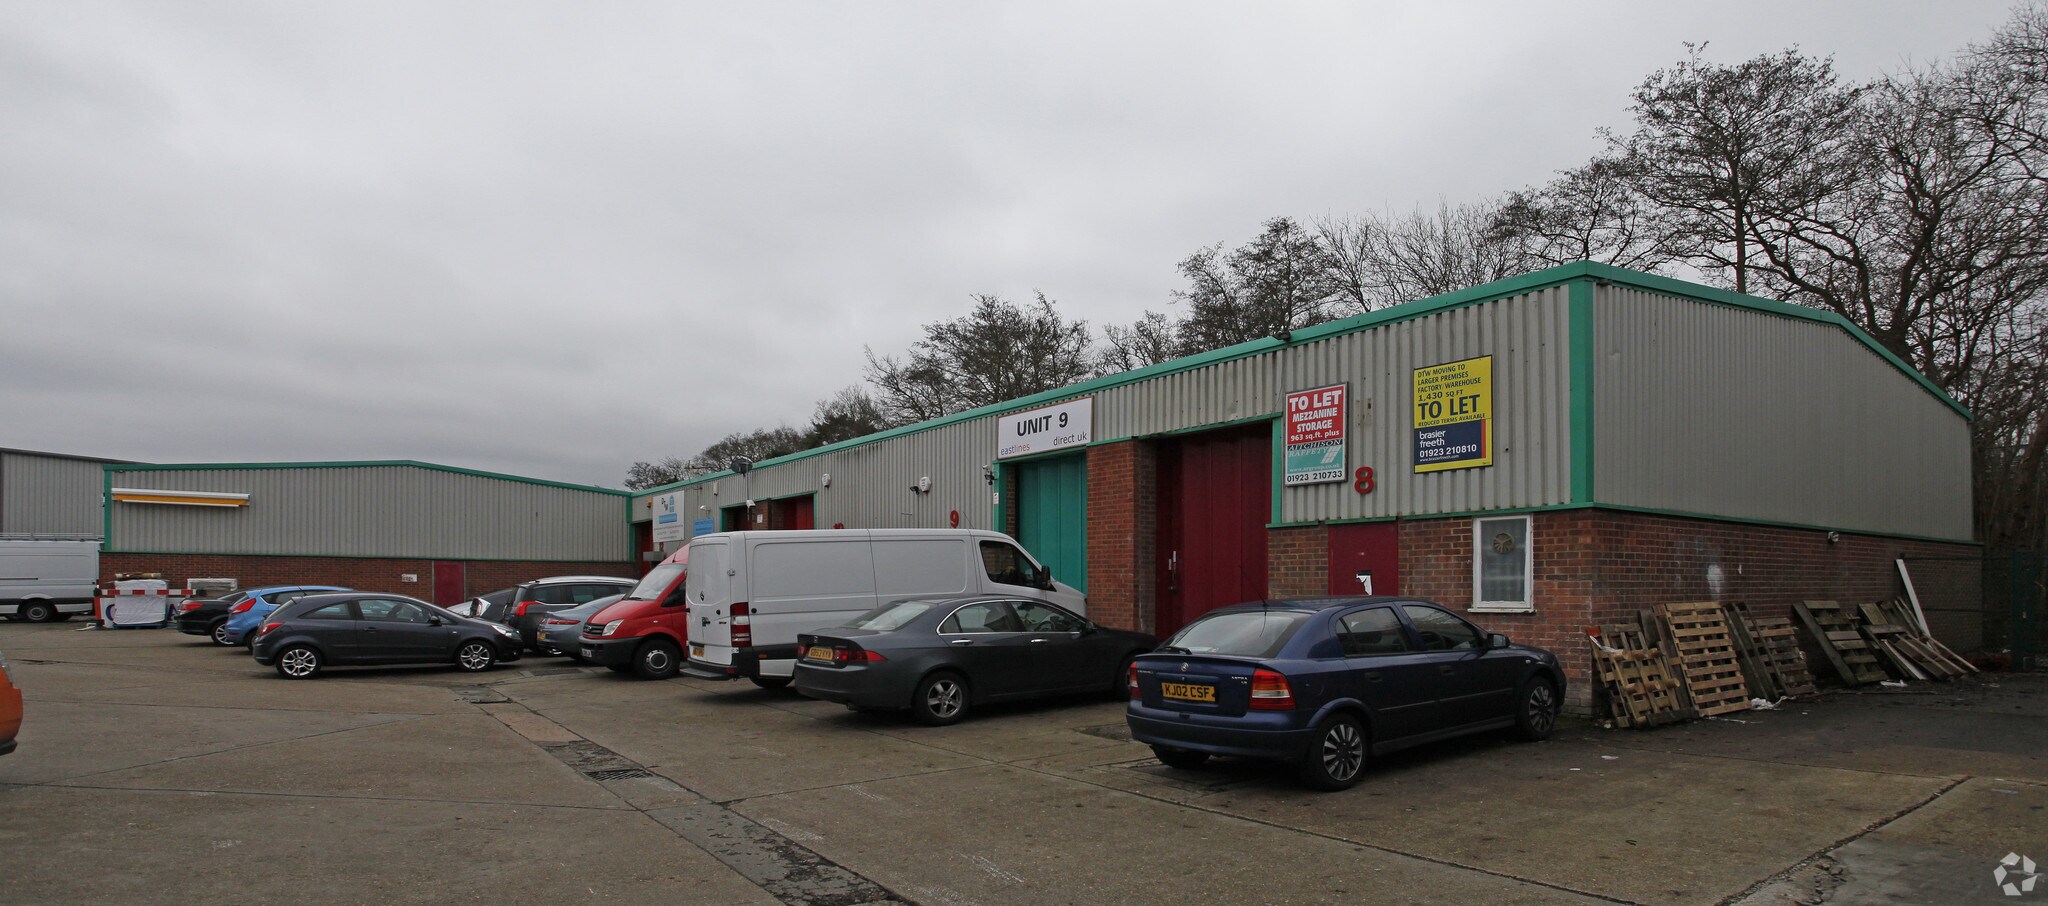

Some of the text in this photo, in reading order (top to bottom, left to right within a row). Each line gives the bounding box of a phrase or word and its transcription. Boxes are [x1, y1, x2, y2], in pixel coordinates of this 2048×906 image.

[1433, 366, 1456, 375] MOVING
[1418, 371, 1469, 385] LARGER PREMISES
[1289, 390, 1342, 412] TO LET
[1418, 393, 1481, 420] TO LET
[1292, 407, 1338, 422] MEZZANINE
[1458, 413, 1485, 421] AVAILABLE
[1017, 412, 1068, 437] UNIT 9
[1297, 419, 1333, 433] STORAGE
[1324, 429, 1340, 438] plus
[1419, 430, 1446, 440] brasier
[1000, 432, 1088, 456] eastlines direct uk
[1419, 438, 1445, 448] freeth
[1419, 444, 1477, 458] 01923 210810
[1287, 470, 1343, 482] 01923 210733
[1354, 466, 1375, 494] 8
[949, 510, 959, 528] 9
[1165, 686, 1210, 698] KJ02 CSF
